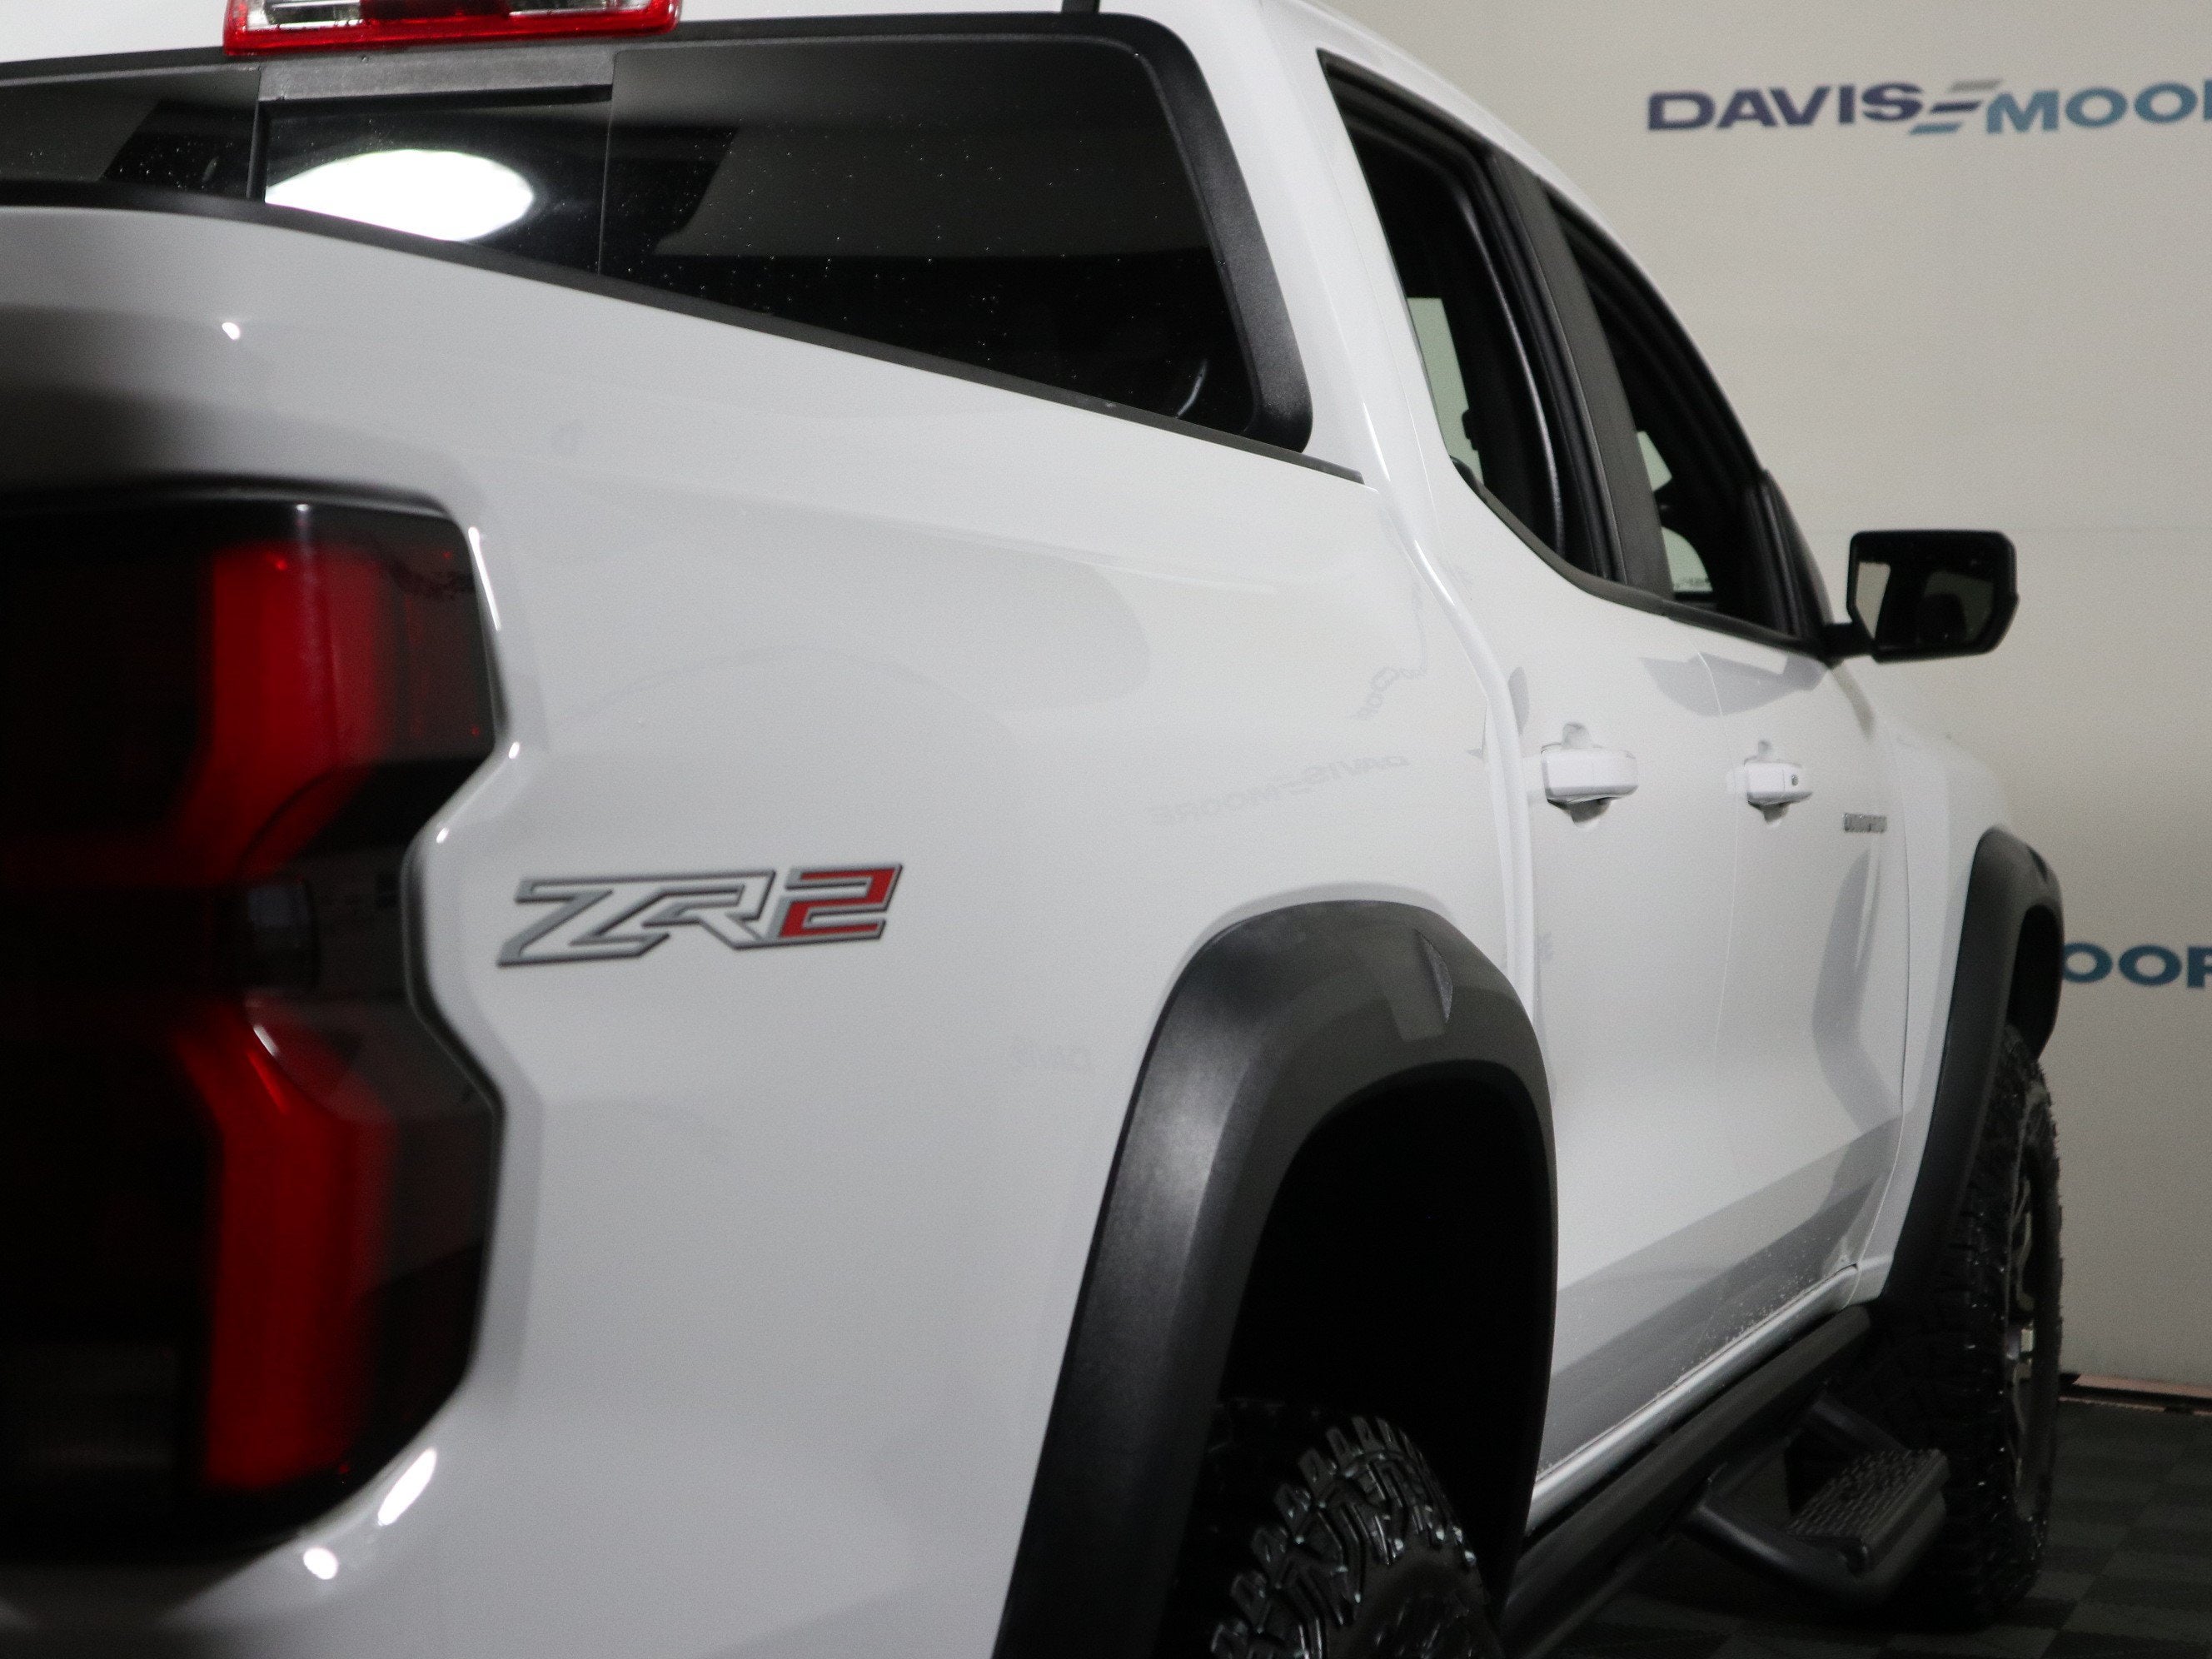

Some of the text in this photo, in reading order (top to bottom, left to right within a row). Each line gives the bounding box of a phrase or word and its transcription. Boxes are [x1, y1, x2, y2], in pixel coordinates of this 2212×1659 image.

[1647, 79, 2212, 135] DAVIS MOO
[496, 864, 903, 968] ZR2
